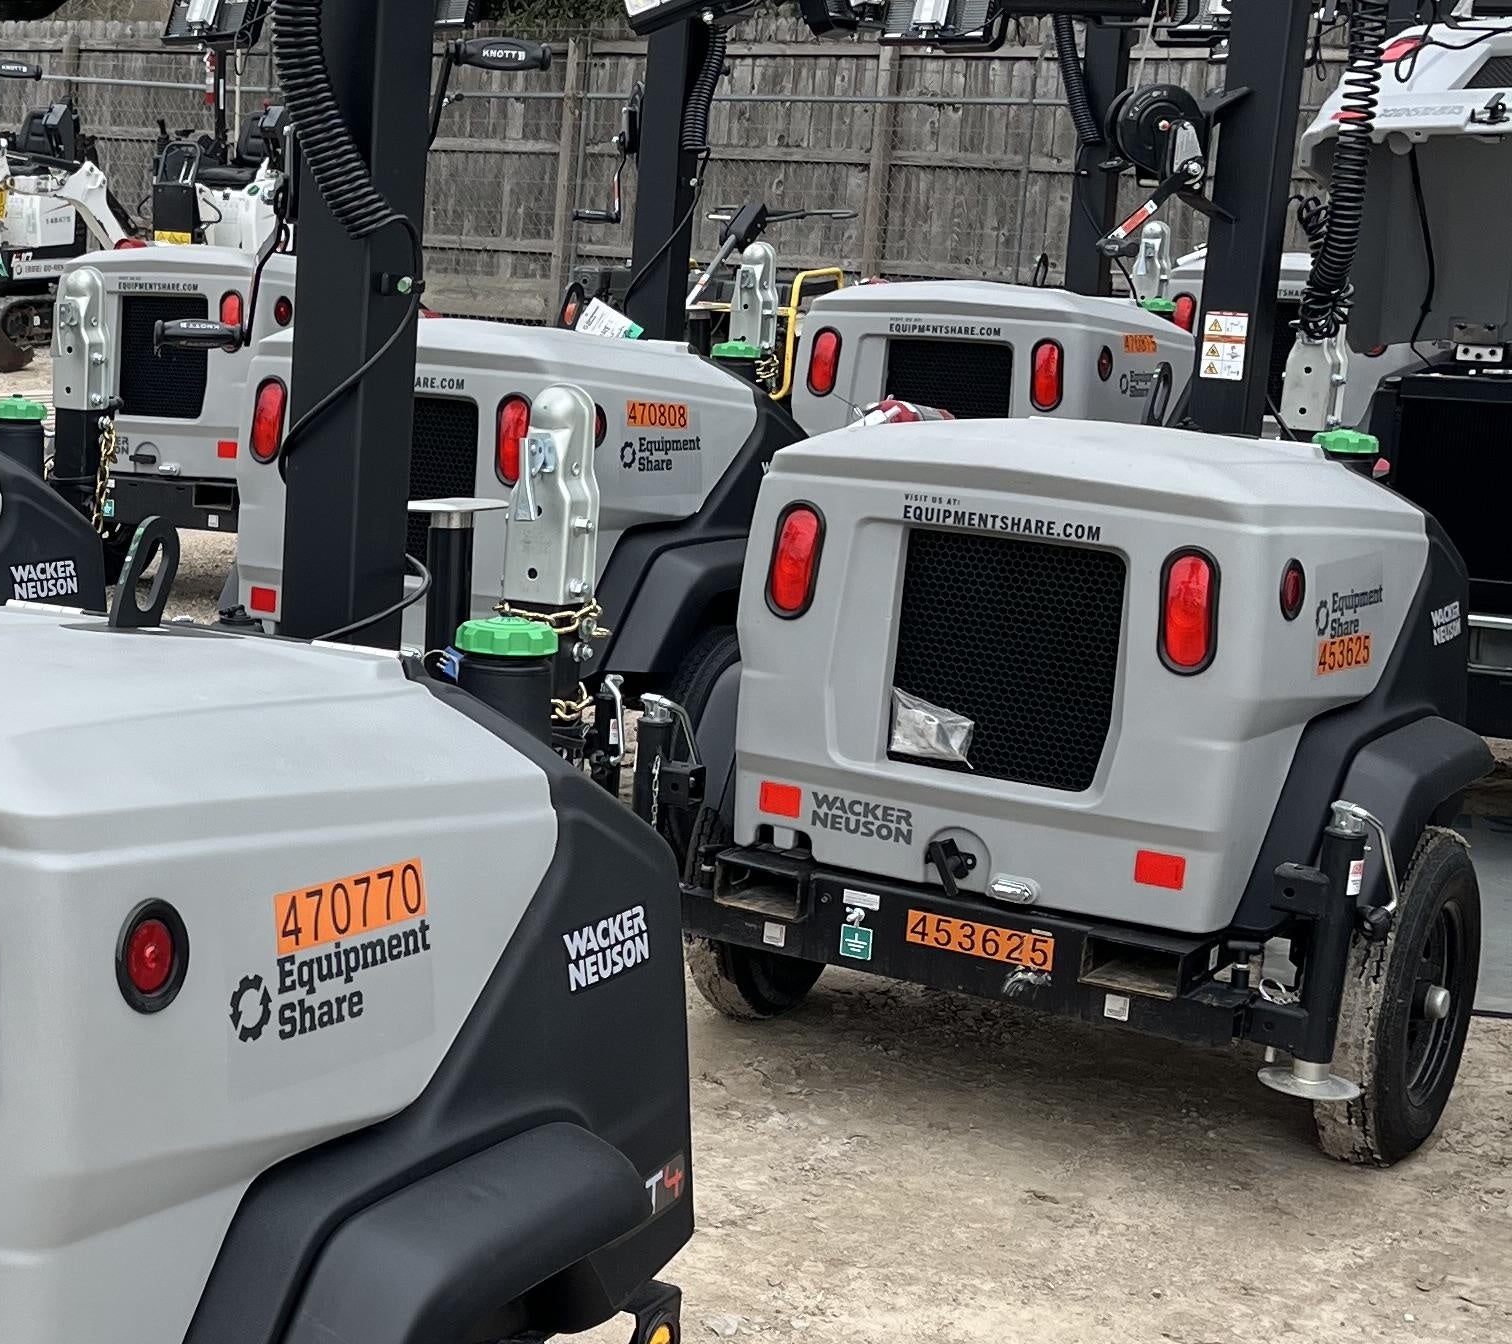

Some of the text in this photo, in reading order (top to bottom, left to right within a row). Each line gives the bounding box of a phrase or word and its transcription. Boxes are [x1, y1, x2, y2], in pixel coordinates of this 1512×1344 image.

[889, 323, 1001, 336] EQUIPMENTSHARE.COM
[628, 402, 687, 428] 470808
[638, 436, 701, 454] Equipment
[638, 456, 673, 472] Share
[903, 505, 1102, 542] EQUIPMENTSHARE.COM
[10, 560, 77, 583] WACKER
[13, 576, 78, 600] NEUSON
[1331, 585, 1384, 617] Equipment
[1330, 617, 1360, 639] Share
[1318, 635, 1370, 672] 453625
[812, 791, 913, 827] WACKER
[811, 810, 913, 846] NEUSON
[280, 860, 422, 947] 470770
[562, 904, 648, 960] WACKER
[909, 911, 1050, 968] 453625
[277, 919, 430, 994] Equipment
[568, 932, 649, 992] NEUSON
[278, 989, 364, 1041] Share
